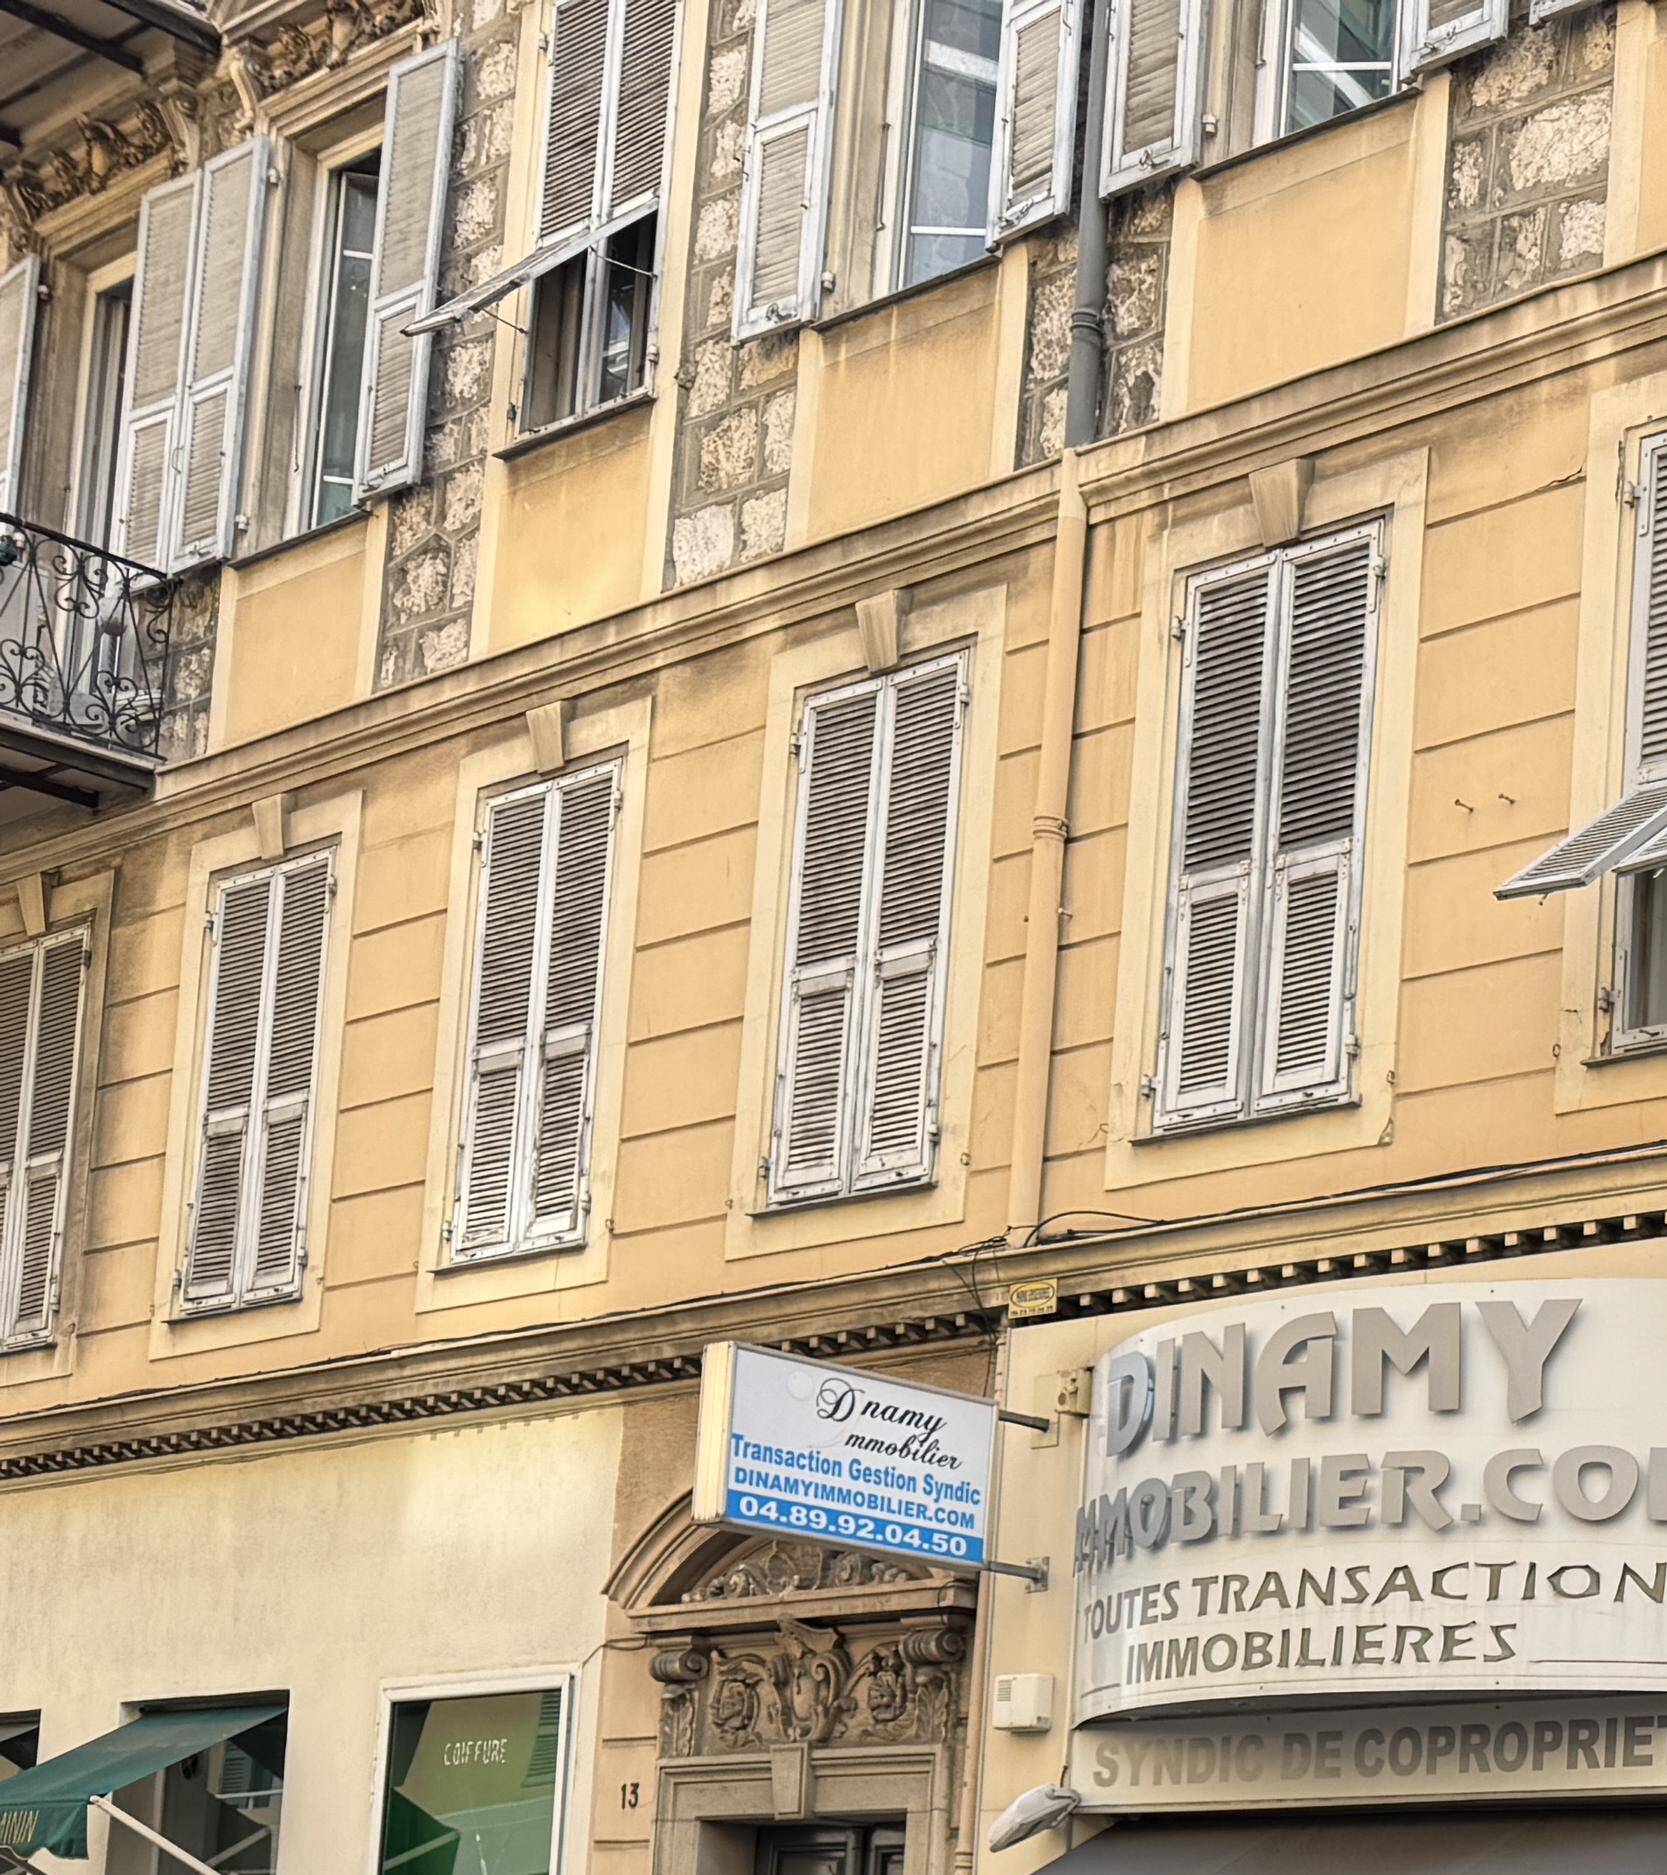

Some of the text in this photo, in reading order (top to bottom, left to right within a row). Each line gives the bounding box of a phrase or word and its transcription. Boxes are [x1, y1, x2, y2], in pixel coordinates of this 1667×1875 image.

[1105, 1297, 1583, 1458] DINAMY
[731, 1433, 982, 1507] Transaction Gestion Syndic
[734, 1466, 976, 1531] DINAMYIMMOBILIER.COM
[739, 1496, 967, 1557] 04.89.92.04.50
[1083, 1579, 1181, 1644] TOUTES
[1125, 1622, 1518, 1686] IMMOBILIERES
[443, 1739, 509, 1766] COIFFURE
[1092, 1734, 1273, 1789] SYNDIC
[1281, 1730, 1343, 1780] DE
[620, 1782, 641, 1811] 13
